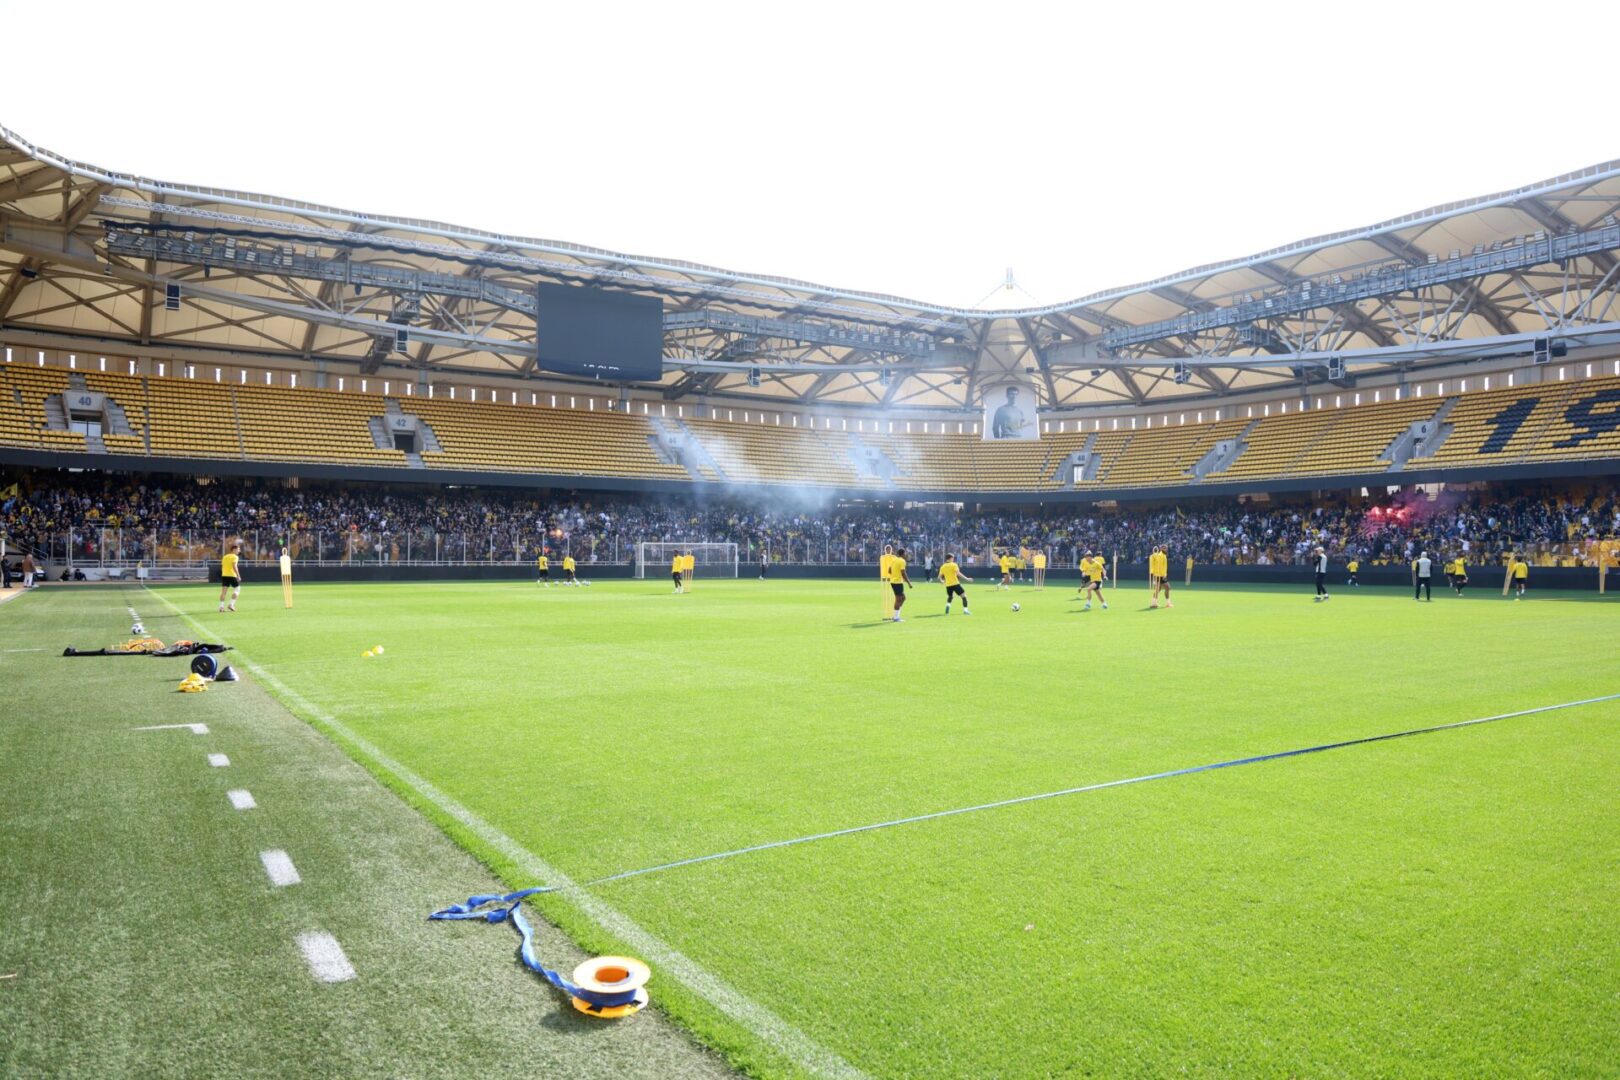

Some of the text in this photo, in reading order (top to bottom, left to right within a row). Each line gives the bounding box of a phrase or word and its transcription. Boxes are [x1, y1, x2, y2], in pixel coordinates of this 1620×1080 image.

[78, 396, 92, 406] 40
[396, 418, 406, 427] 42
[1421, 425, 1428, 434] 6
